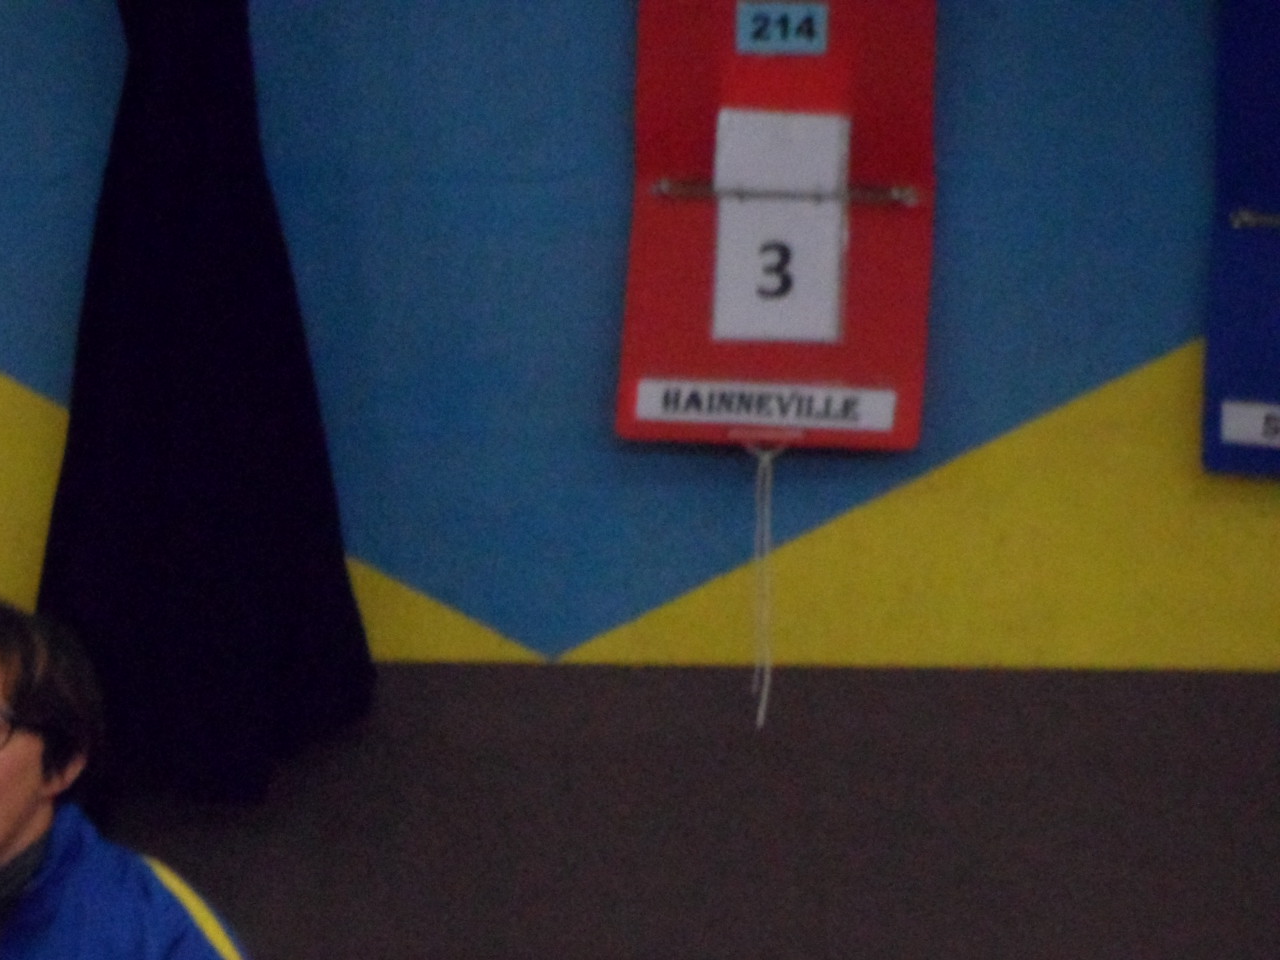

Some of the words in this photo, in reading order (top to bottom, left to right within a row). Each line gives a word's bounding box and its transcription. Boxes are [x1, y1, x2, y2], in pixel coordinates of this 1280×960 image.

[751, 11, 817, 42] 214
[756, 241, 794, 301] 3
[661, 388, 861, 421] HAINNEVILLE
